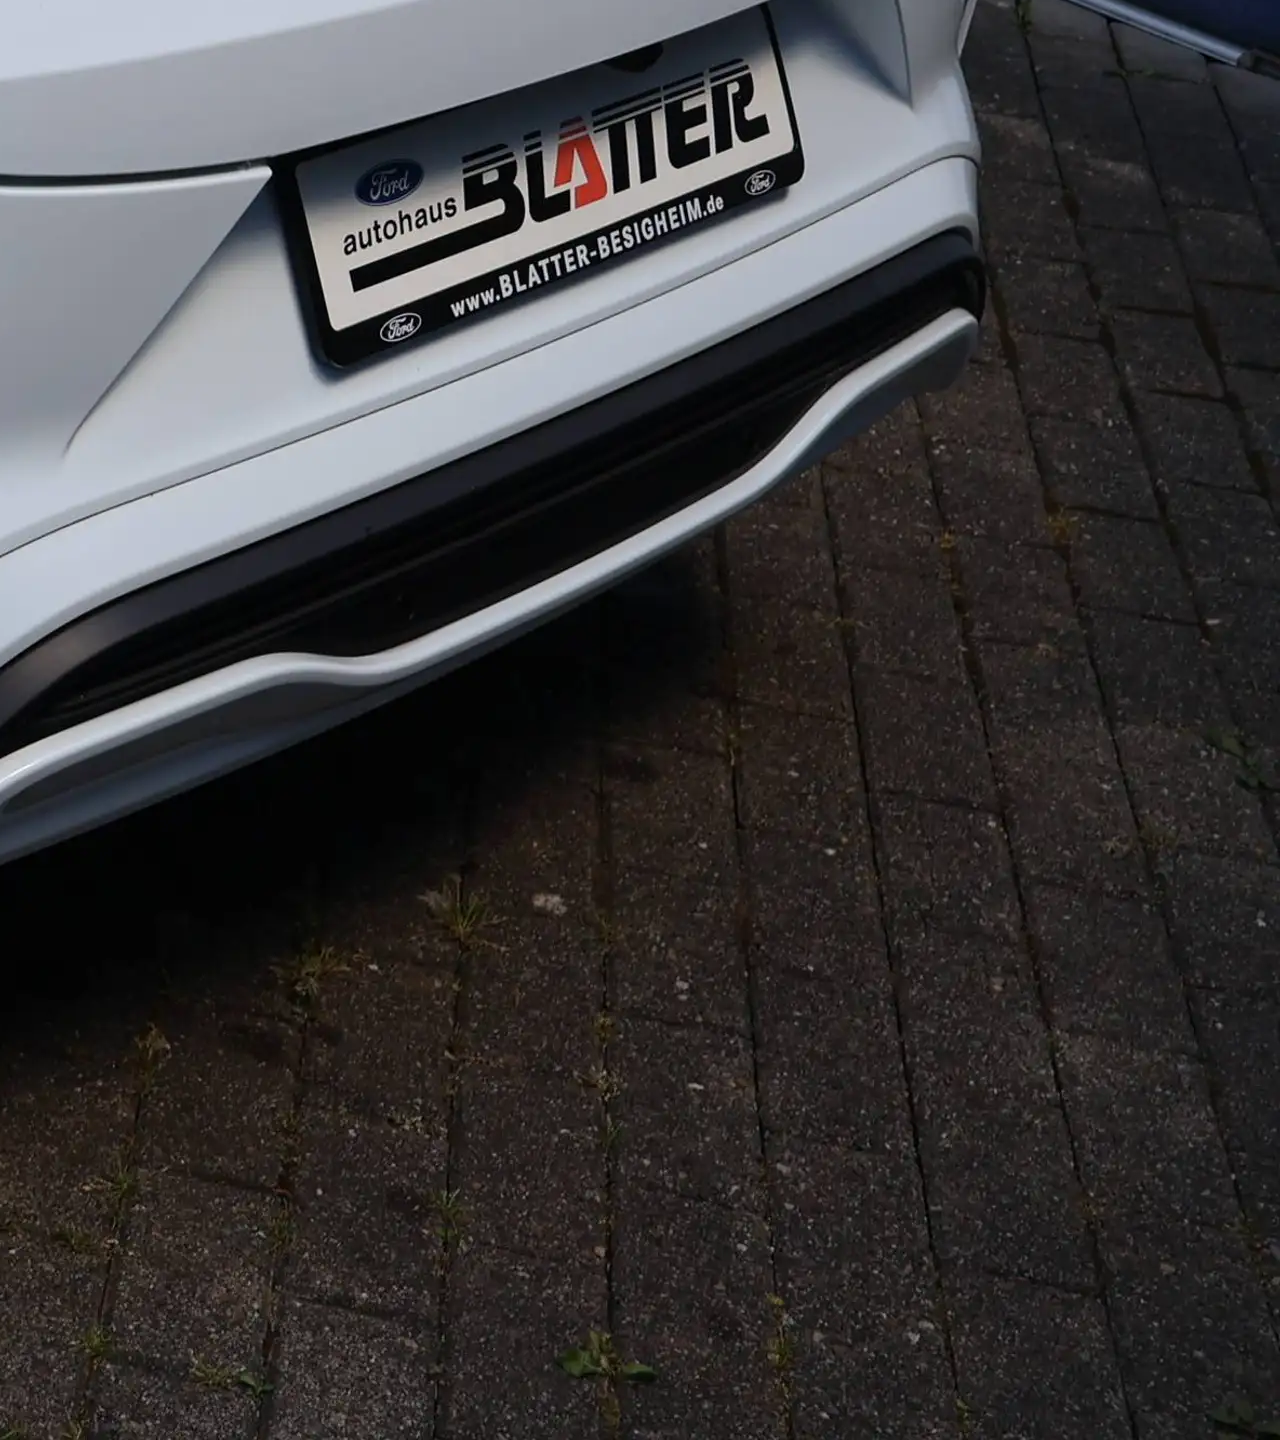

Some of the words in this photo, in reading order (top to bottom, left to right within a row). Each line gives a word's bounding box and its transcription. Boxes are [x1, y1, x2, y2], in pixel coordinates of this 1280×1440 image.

[343, 196, 458, 256] autohaus
[461, 58, 770, 236] BLATTER
[370, 167, 411, 201] Ford
[450, 193, 725, 318] www.BLATTER-BESIGHEIM.de
